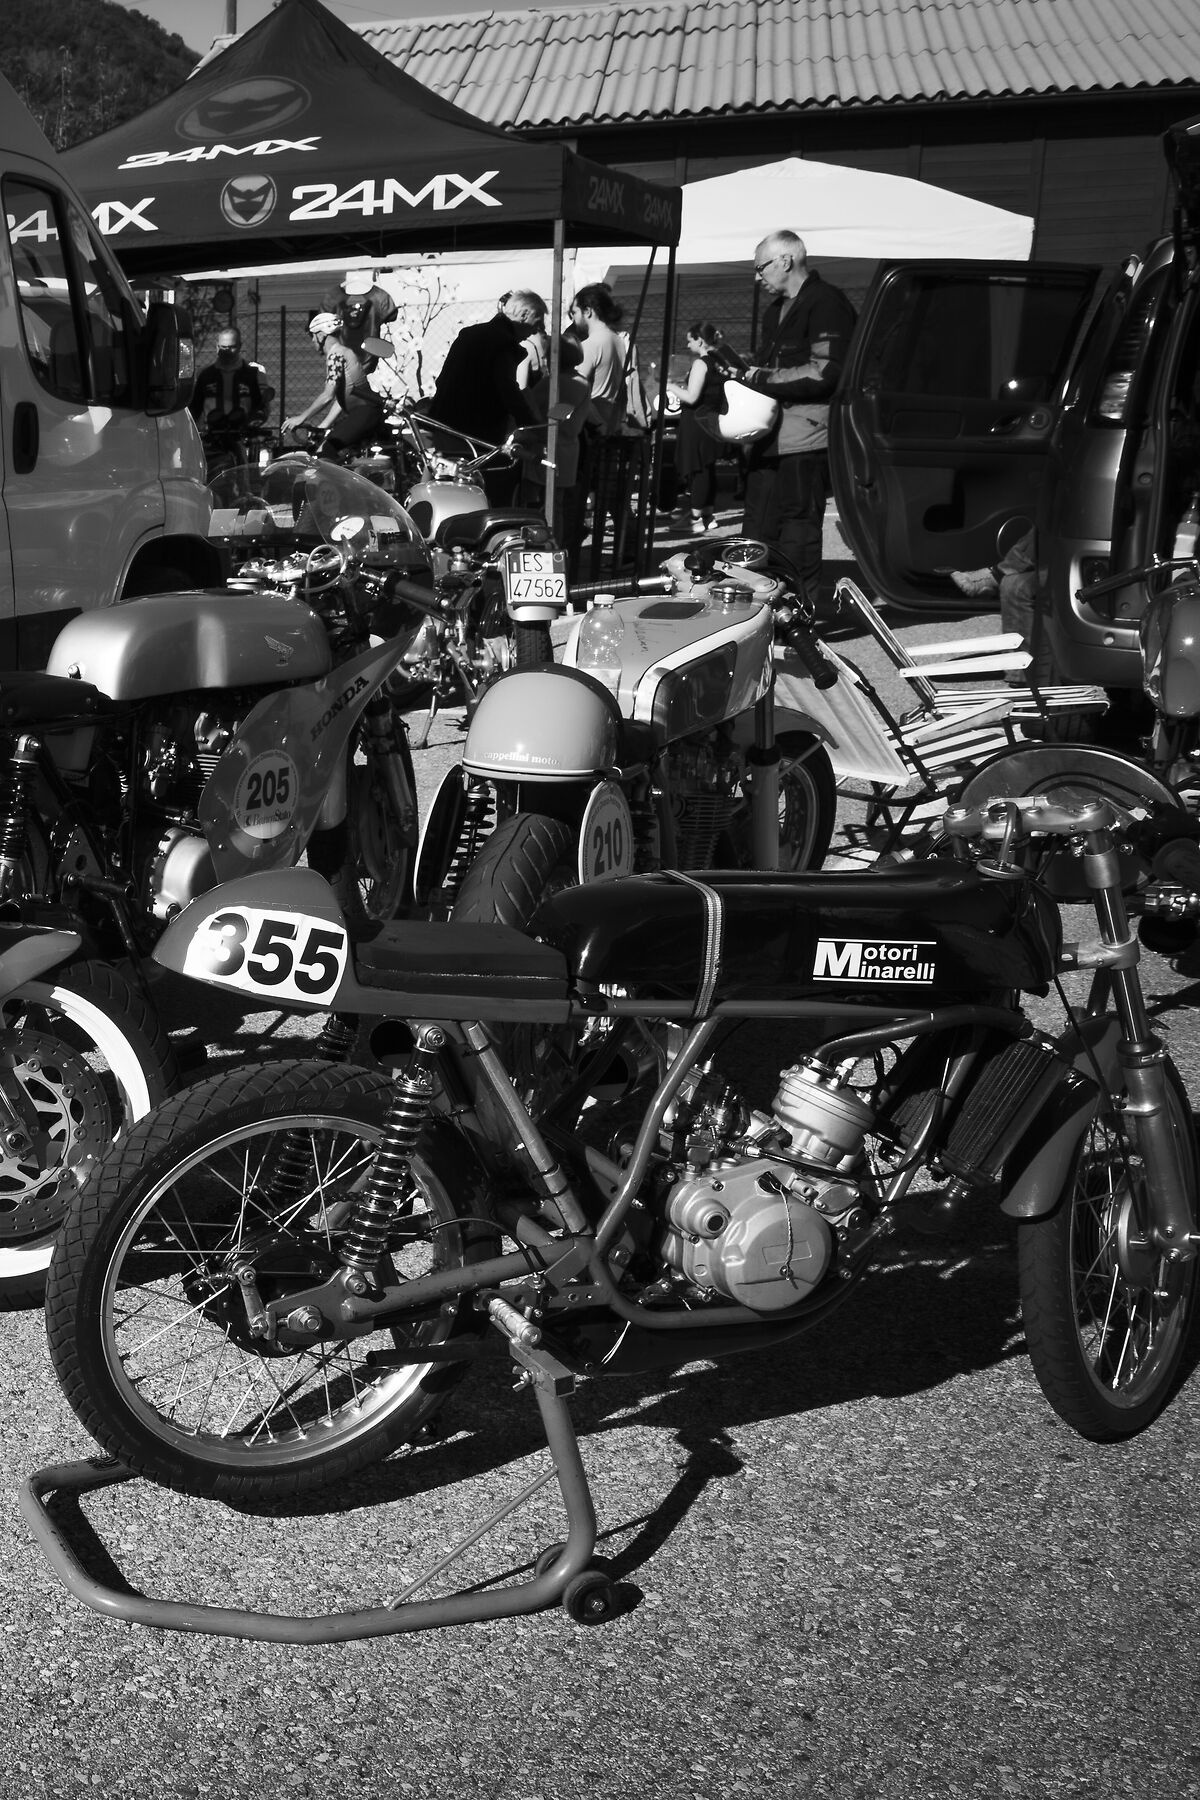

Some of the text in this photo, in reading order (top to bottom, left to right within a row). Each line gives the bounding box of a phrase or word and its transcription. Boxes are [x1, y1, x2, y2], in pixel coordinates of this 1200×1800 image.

[117, 136, 322, 170] 24MX
[289, 170, 504, 221] 24MX
[588, 175, 625, 215] 24MX
[643, 193, 673, 231] 24MX
[523, 553, 543, 572] ES
[514, 579, 564, 598] 47562
[310, 676, 370, 742] HONDA
[246, 767, 290, 810] 205
[593, 818, 623, 877] 210
[204, 912, 345, 995] 355
[813, 941, 918, 977] Motori
